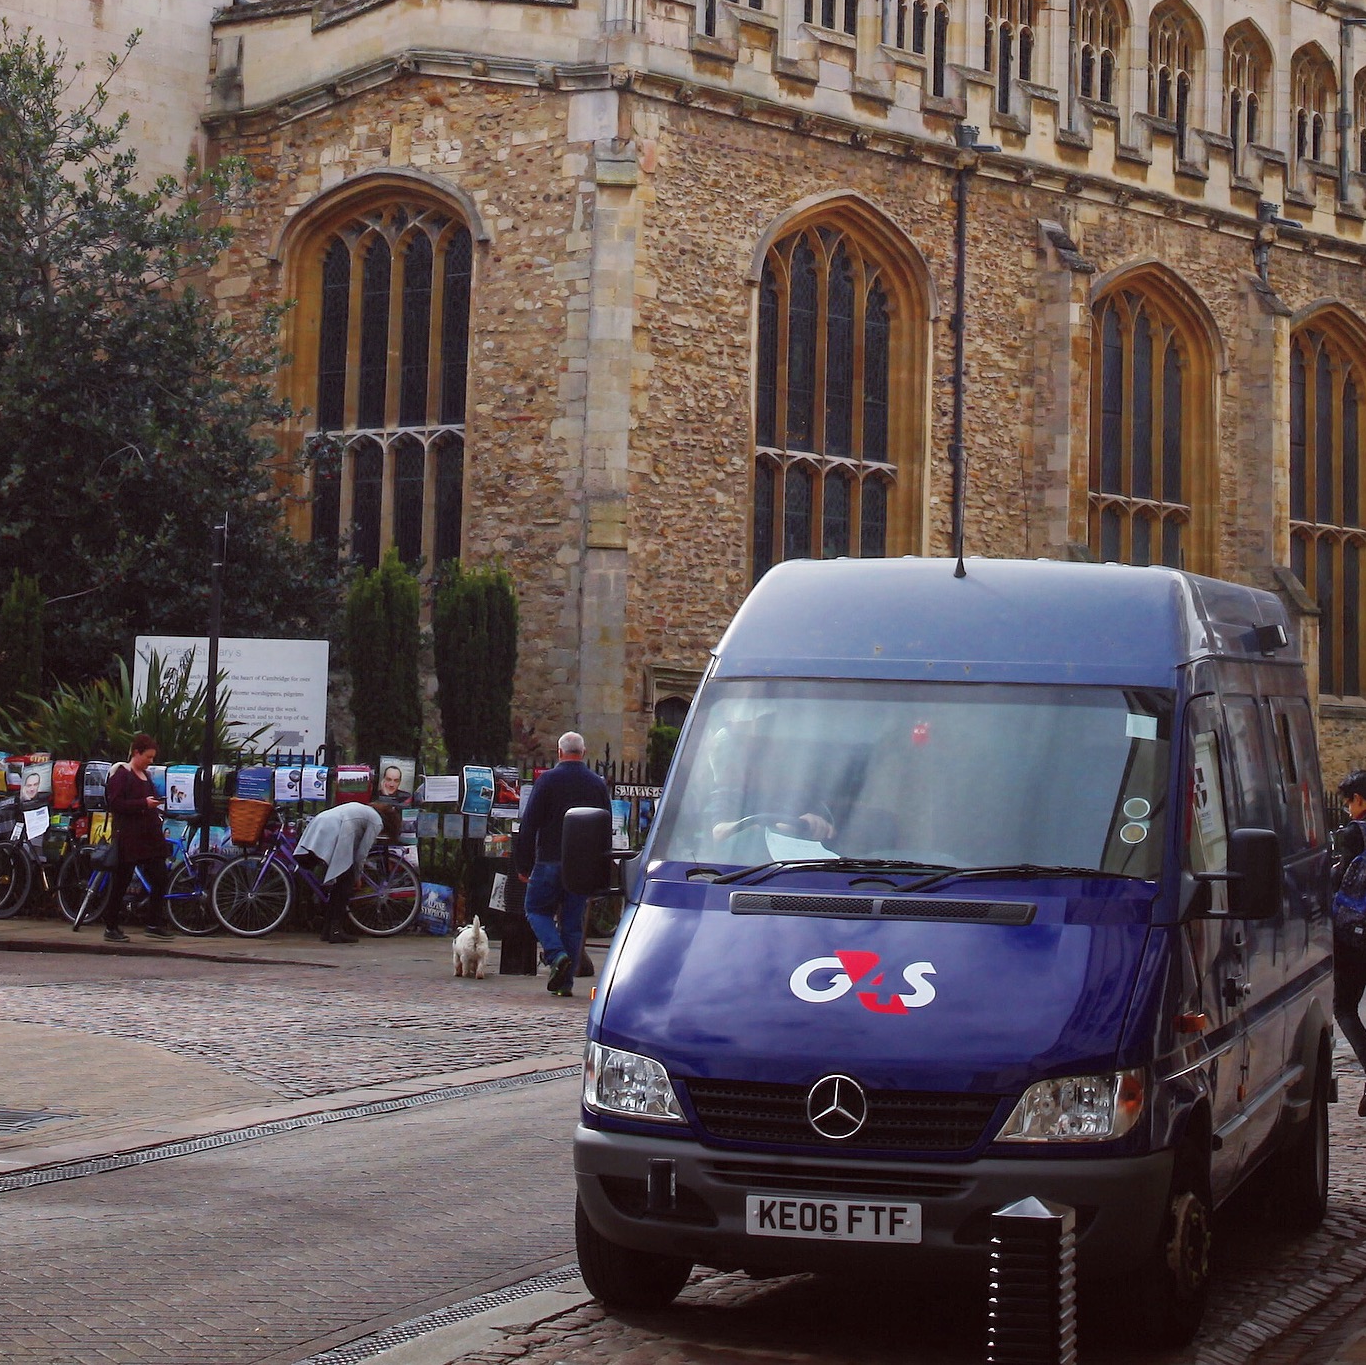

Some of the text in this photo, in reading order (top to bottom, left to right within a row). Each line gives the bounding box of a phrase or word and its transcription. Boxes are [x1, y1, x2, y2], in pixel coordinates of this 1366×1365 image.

[261, 675, 290, 683] Cambridge
[420, 905, 450, 920] SYMPHONY
[789, 950, 938, 1015] G4S
[759, 1199, 908, 1236] KE06 FTF
